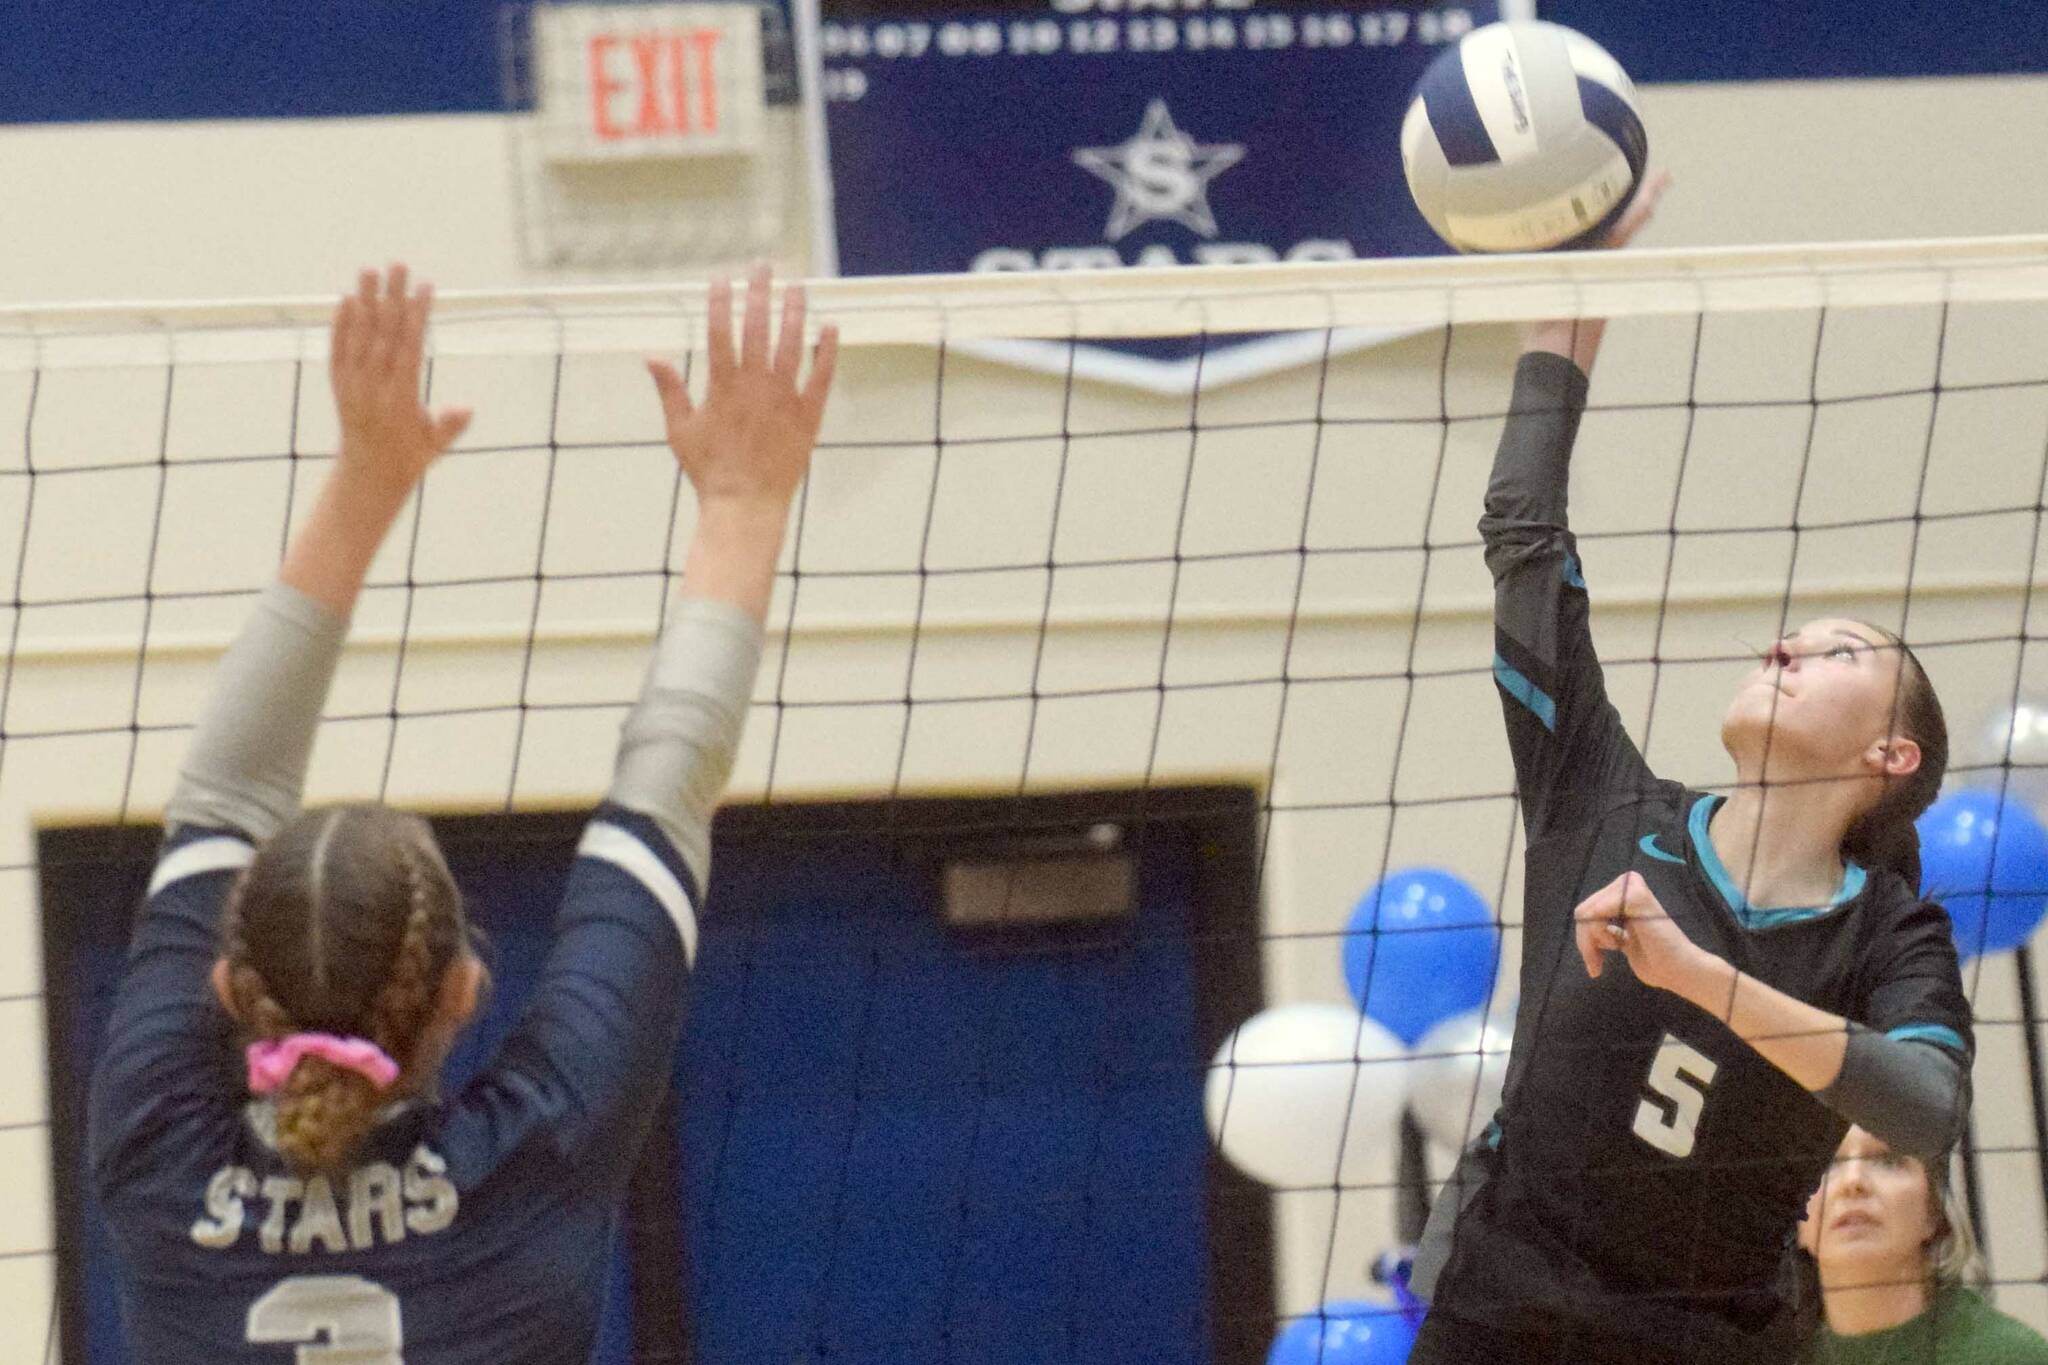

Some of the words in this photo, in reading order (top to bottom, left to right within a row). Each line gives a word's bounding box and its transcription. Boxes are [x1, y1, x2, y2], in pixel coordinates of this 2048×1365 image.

[588, 28, 722, 141] EXIT
[1127, 138, 1198, 214] S
[1632, 1032, 1718, 1158] 5
[190, 1145, 459, 1252] STARS
